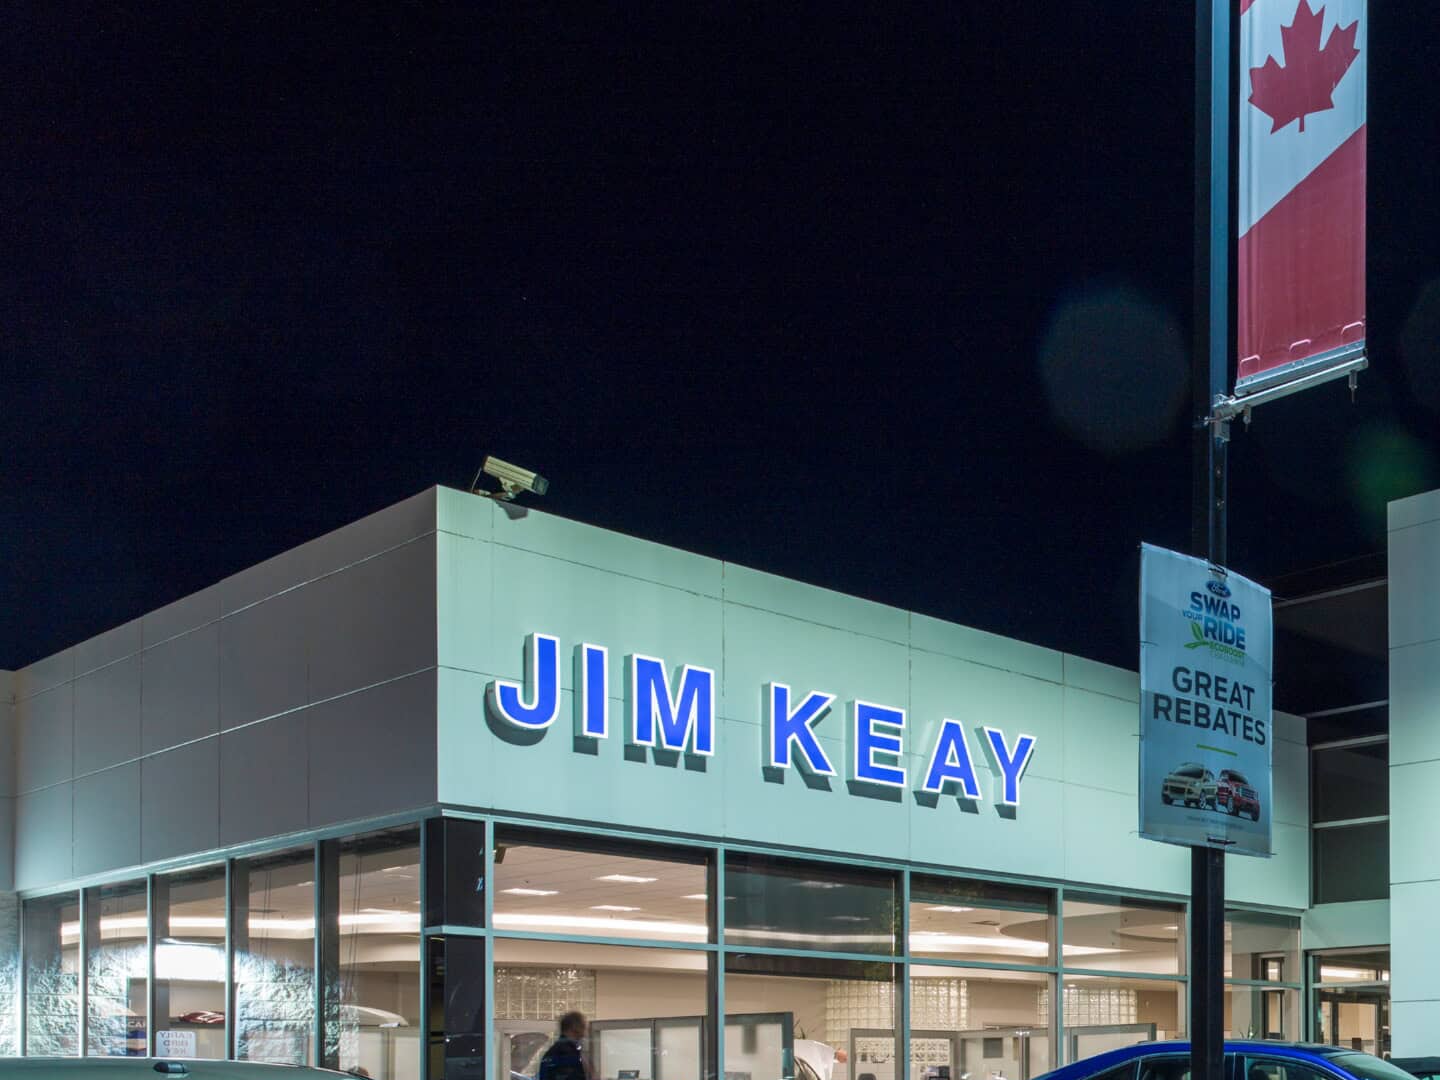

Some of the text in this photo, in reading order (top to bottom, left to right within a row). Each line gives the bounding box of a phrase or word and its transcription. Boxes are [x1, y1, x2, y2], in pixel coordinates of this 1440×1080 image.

[1182, 609, 1203, 621] YOUR
[1190, 591, 1241, 622] SWAP
[1203, 615, 1246, 650] RIDE
[1172, 666, 1255, 711] GREAT
[494, 632, 1037, 806] JIM KEAY
[1153, 693, 1266, 746] REBATES
